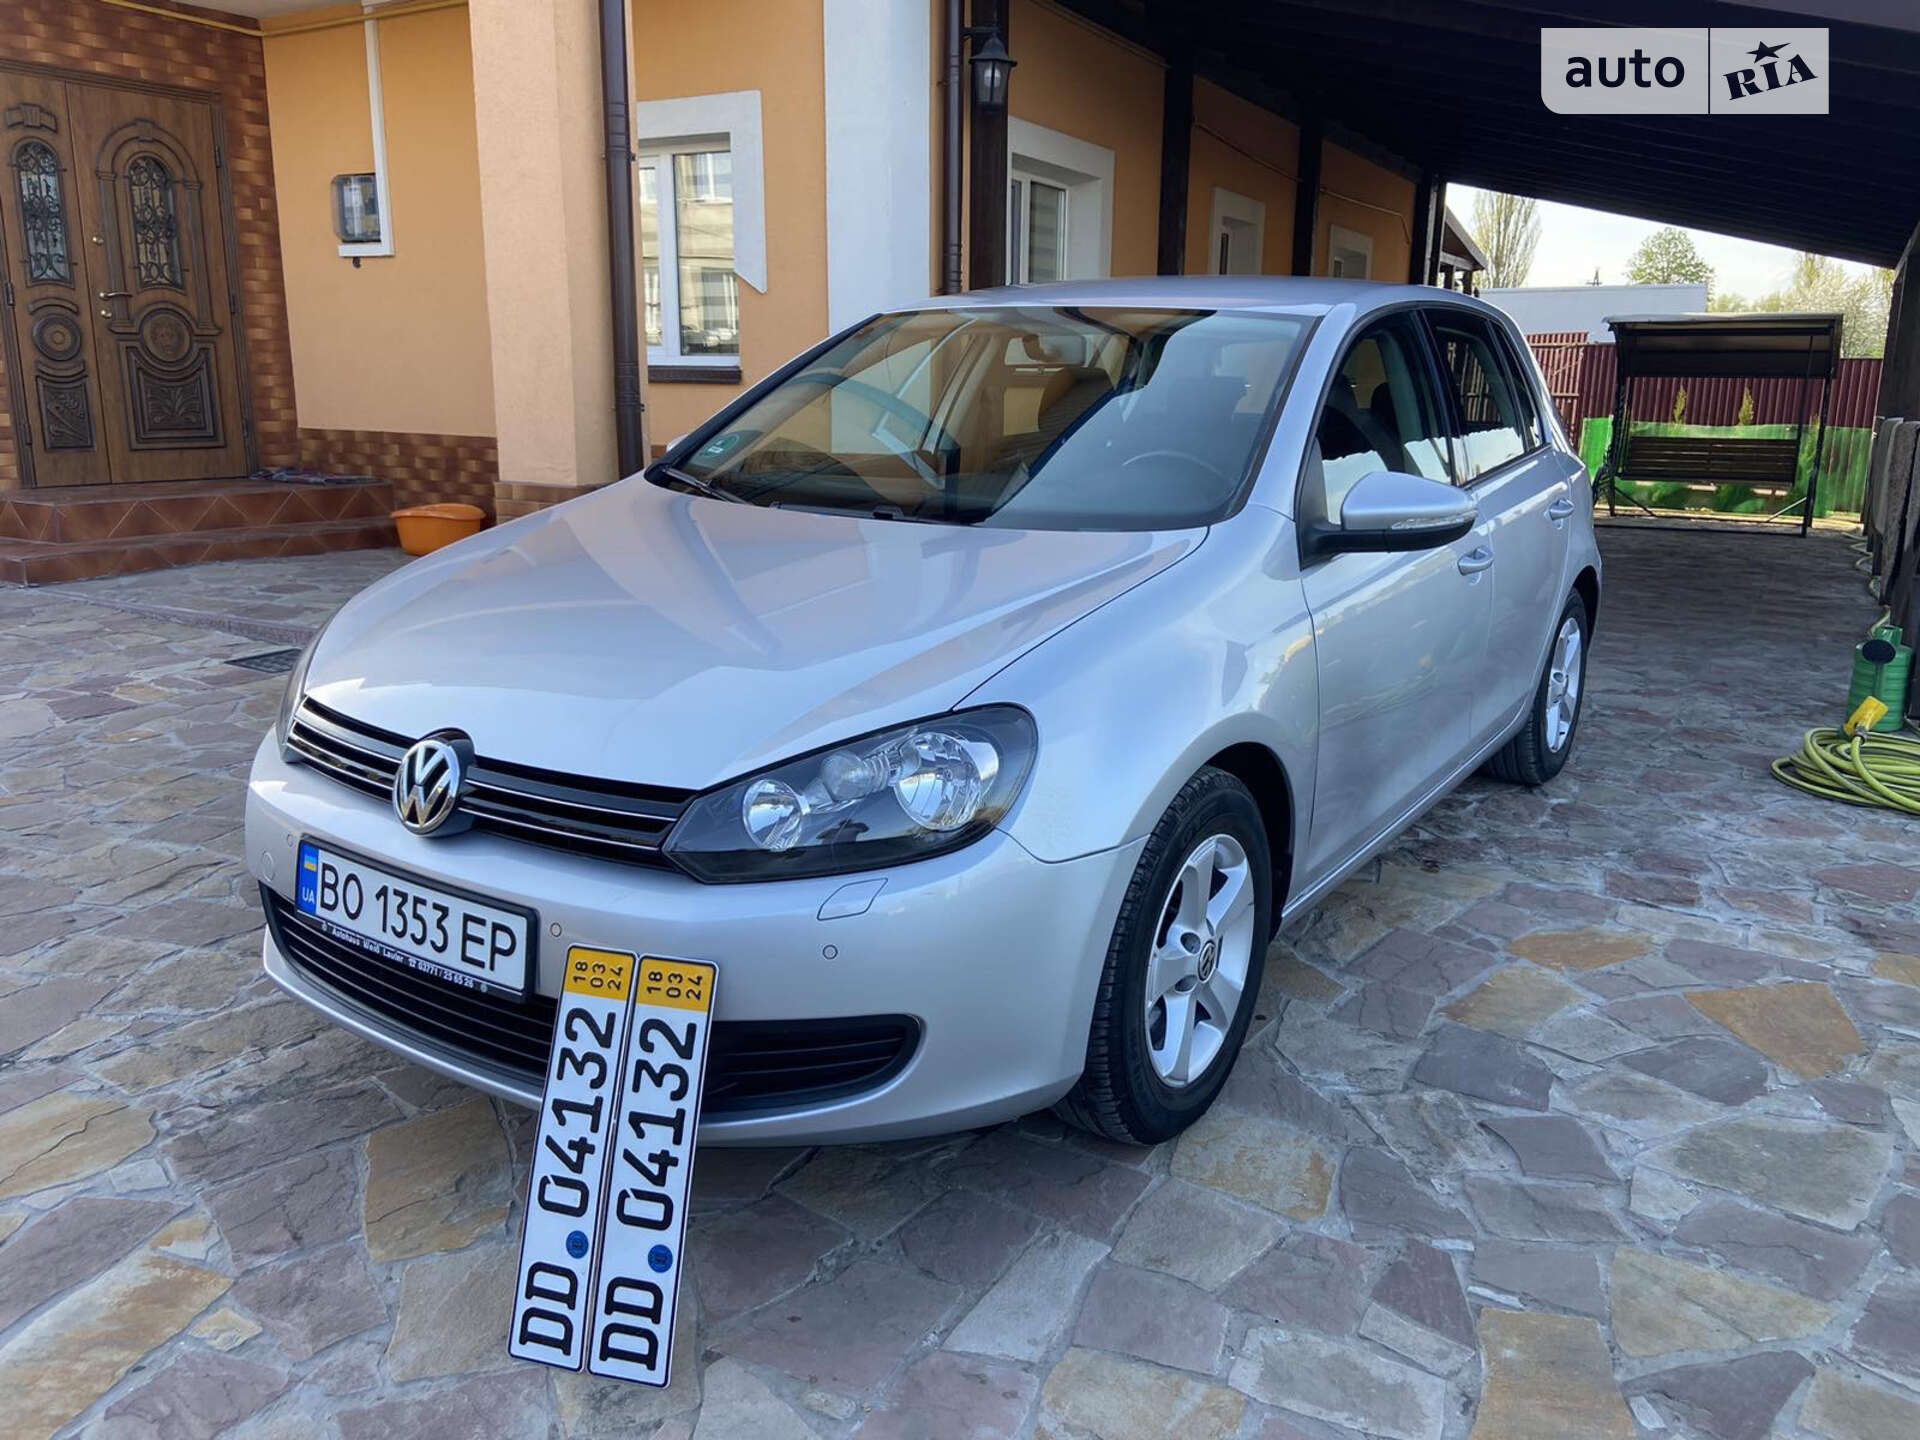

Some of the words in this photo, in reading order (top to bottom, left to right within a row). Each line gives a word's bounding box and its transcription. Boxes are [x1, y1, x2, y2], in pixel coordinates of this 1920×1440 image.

[302, 889, 316, 905] UA
[320, 862, 364, 921] BO
[375, 884, 450, 954] 1353
[461, 912, 518, 972] EP
[573, 960, 589, 984] 18
[590, 962, 606, 988] 03
[607, 966, 624, 991] 24
[646, 971, 664, 995] 18
[666, 972, 684, 999] 03
[685, 975, 704, 1001] 24
[537, 1007, 616, 1218] 04132
[616, 1018, 698, 1231] 04132
[518, 1261, 578, 1356] DD
[599, 1276, 664, 1371] DD
